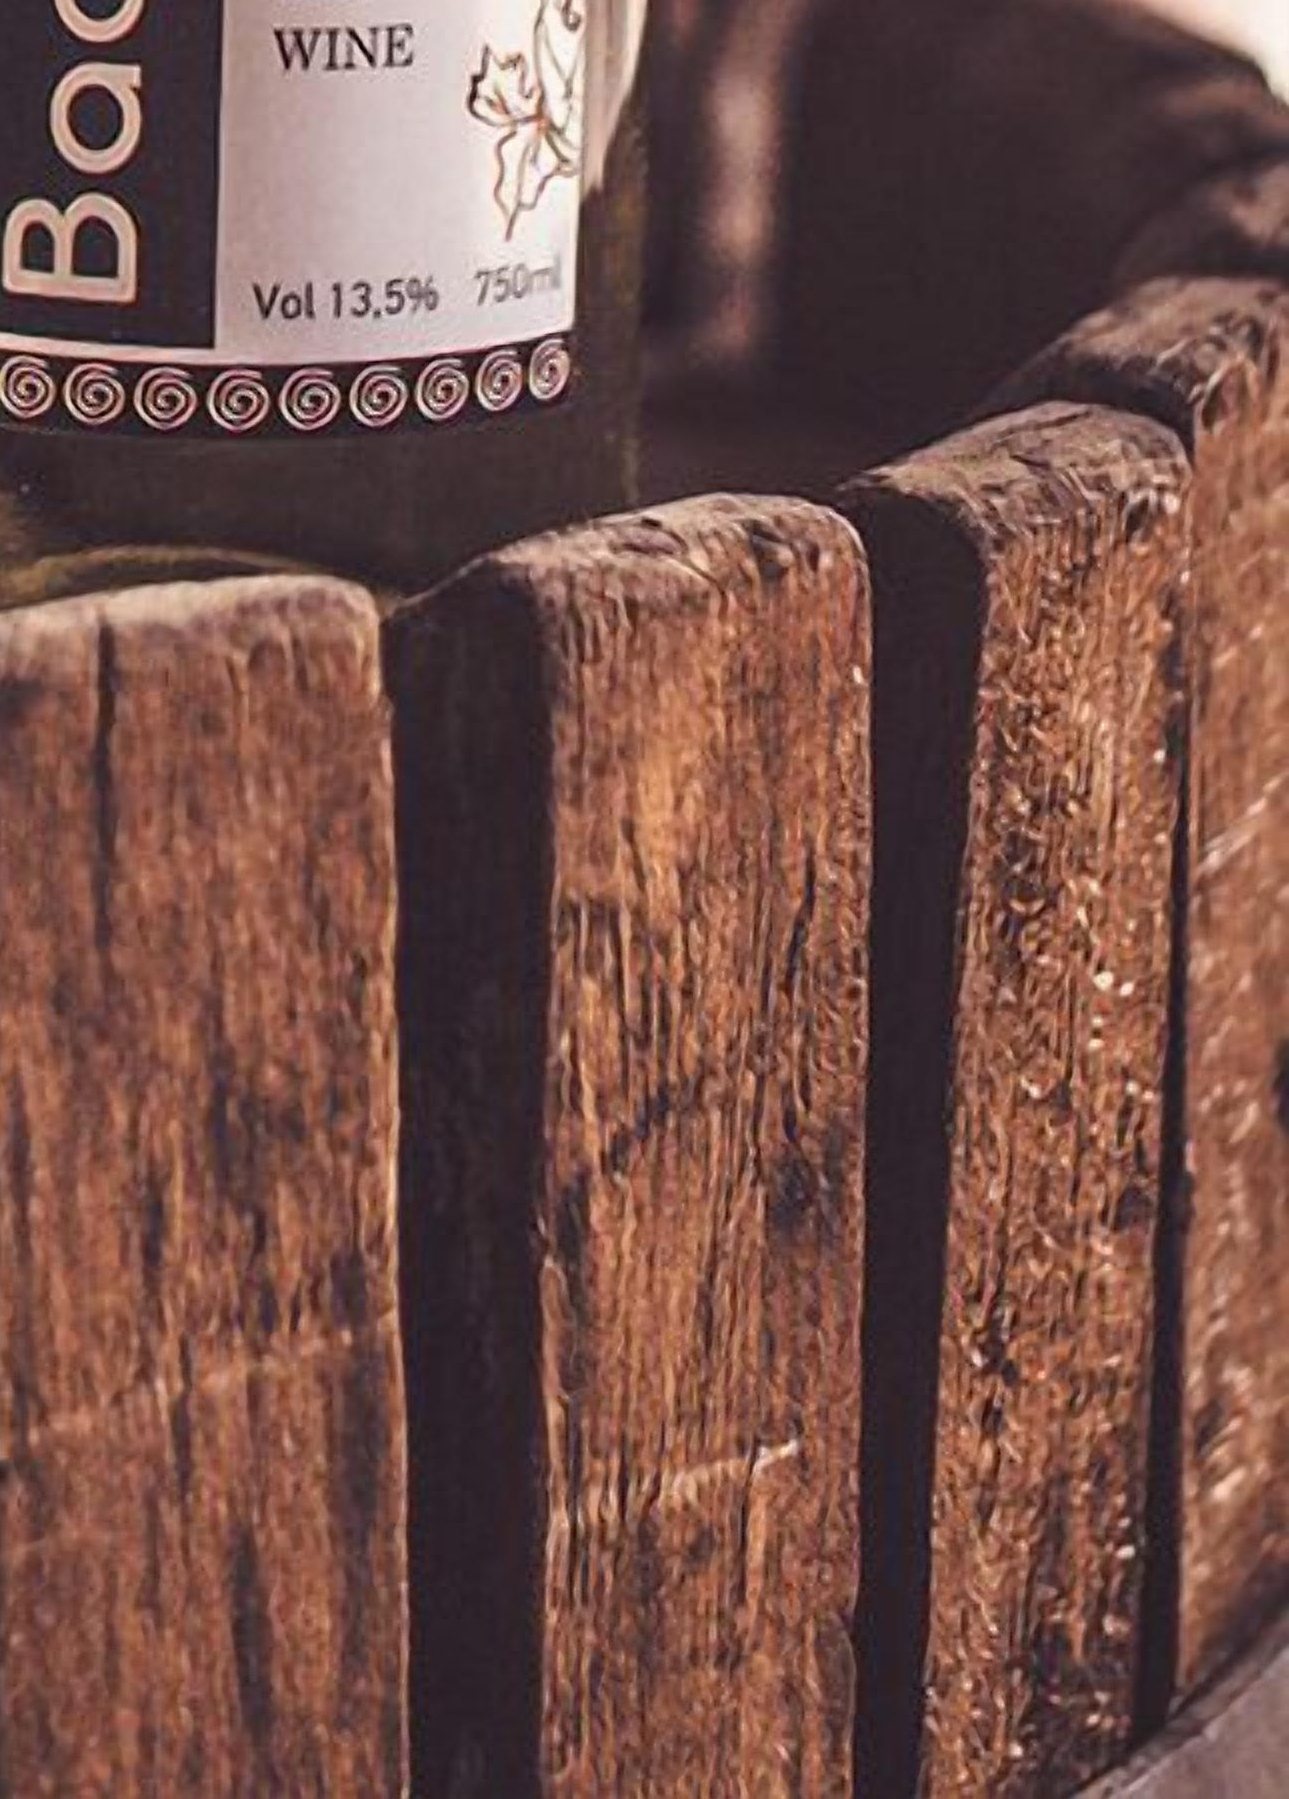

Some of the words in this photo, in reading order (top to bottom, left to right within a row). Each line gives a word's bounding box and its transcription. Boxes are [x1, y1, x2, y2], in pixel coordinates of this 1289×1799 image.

[273, 22, 415, 72] WINE
[252, 275, 316, 320] Vol
[474, 251, 563, 308] 750ml
